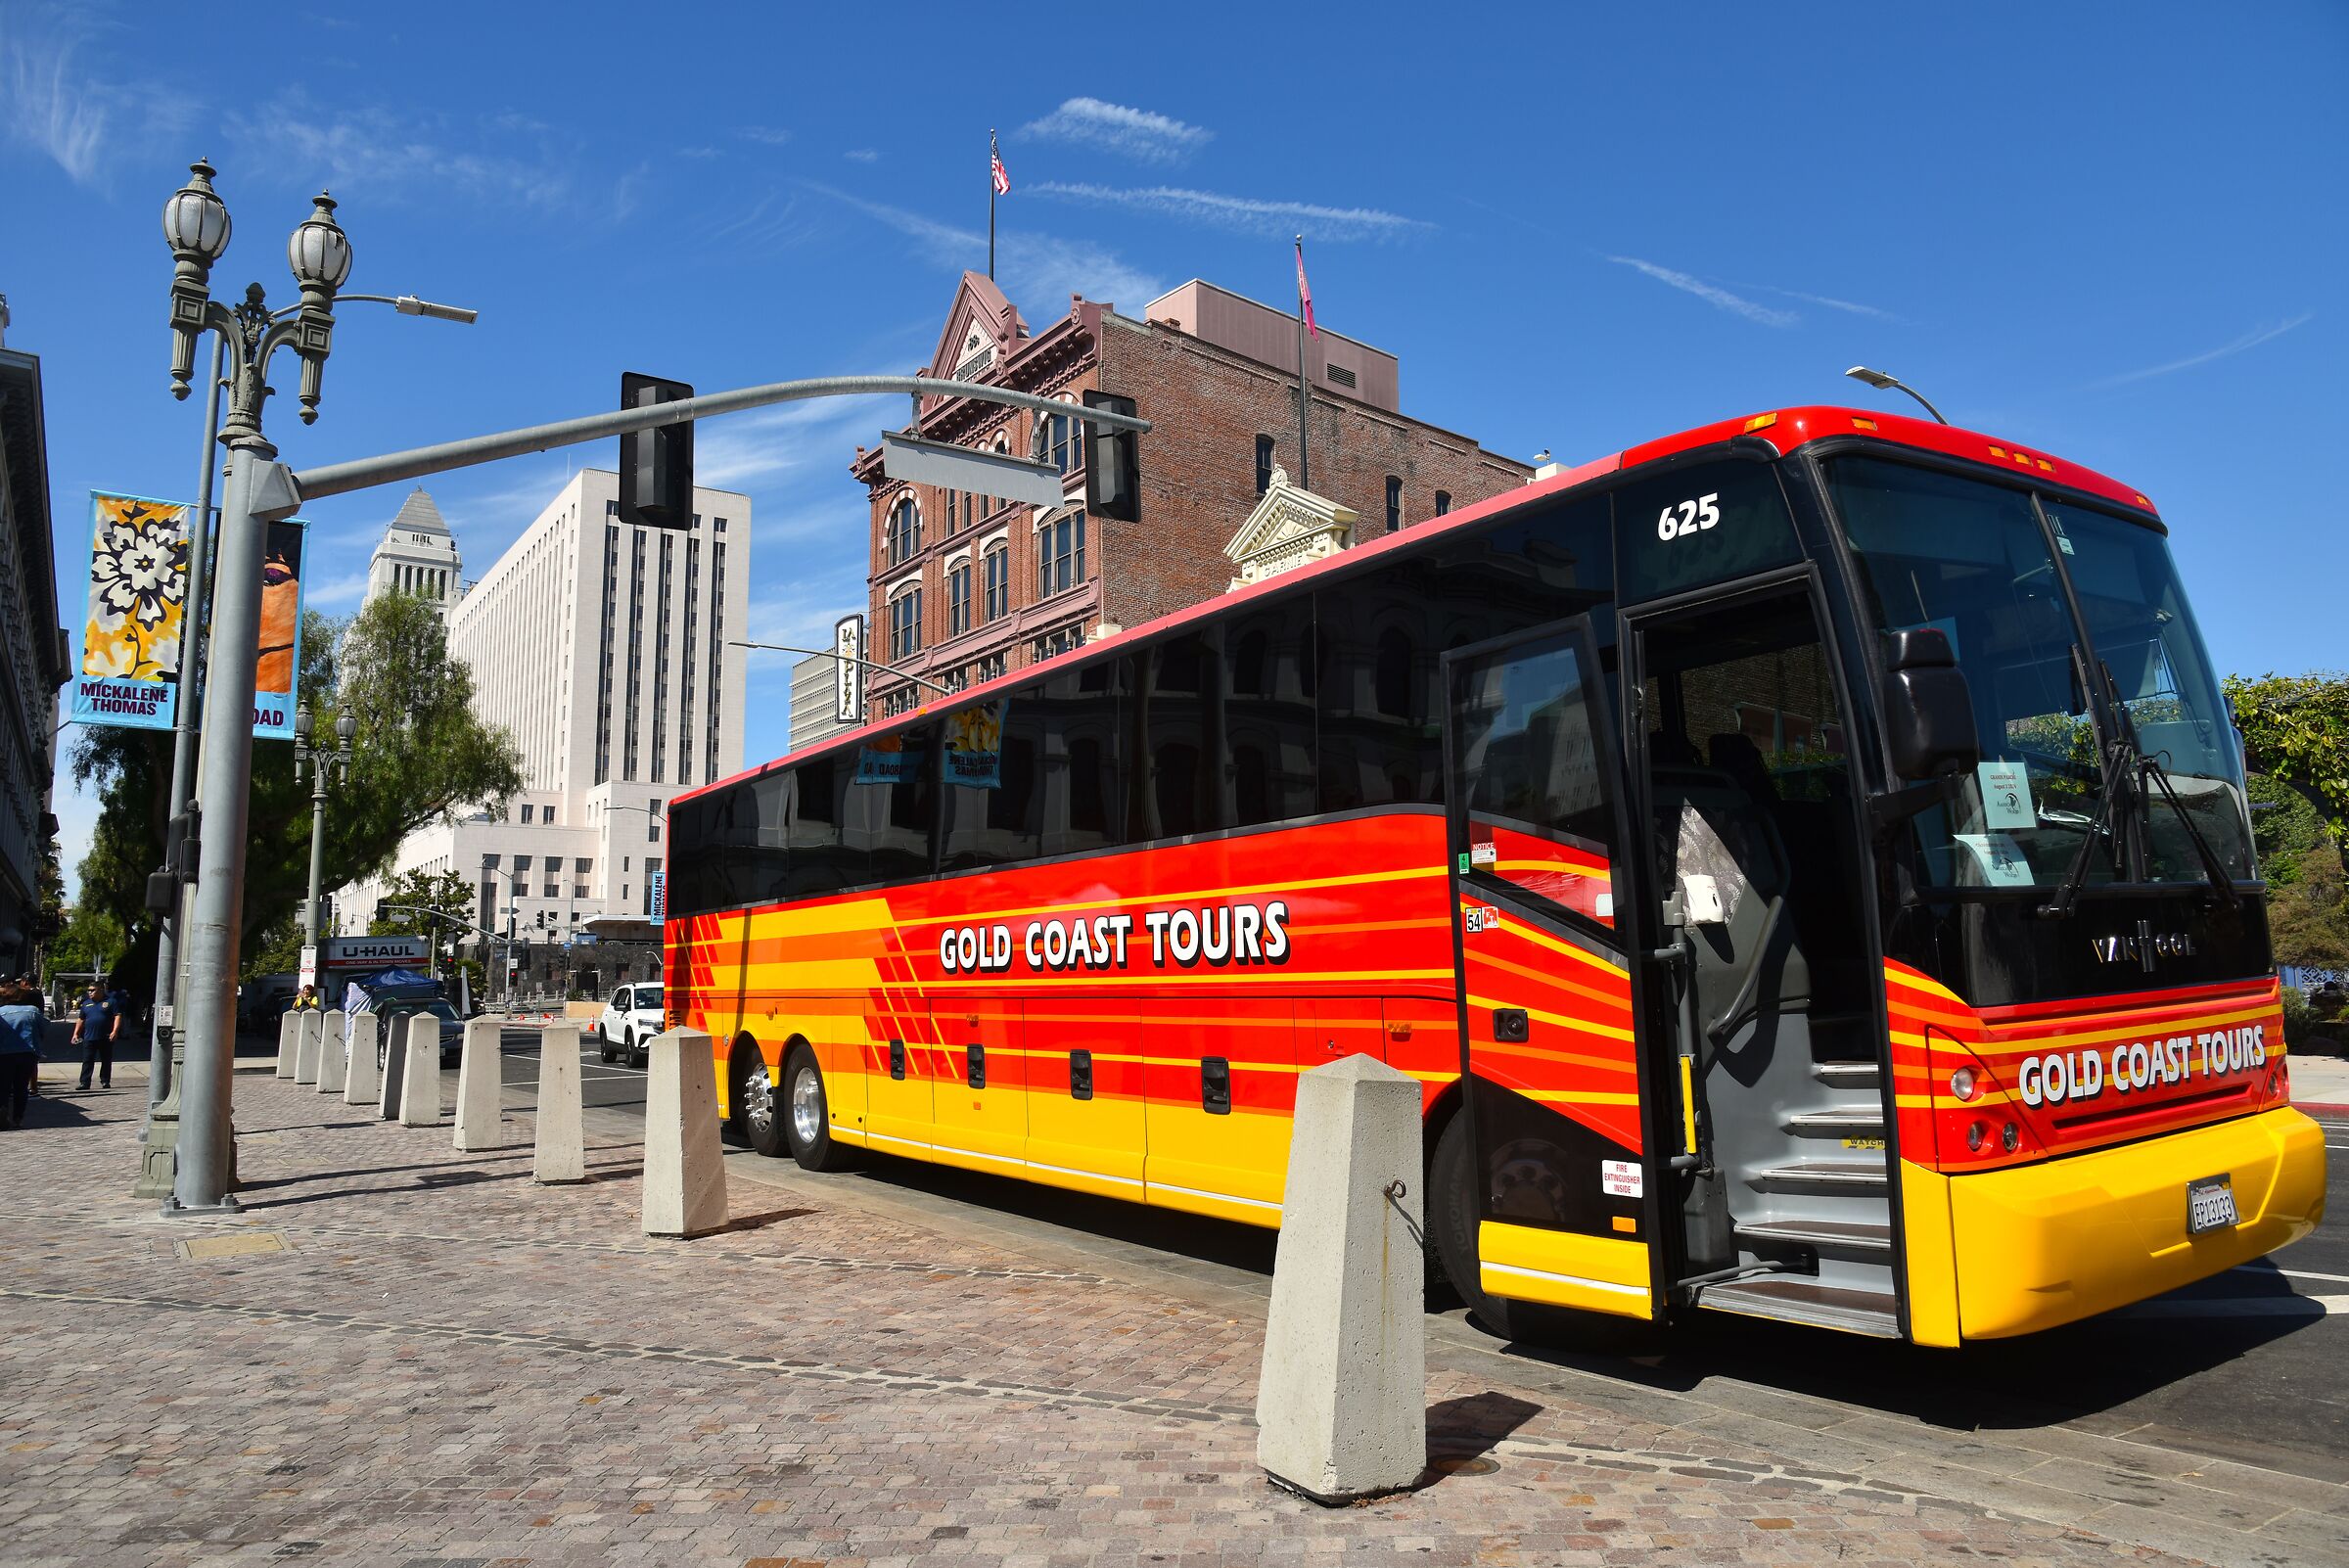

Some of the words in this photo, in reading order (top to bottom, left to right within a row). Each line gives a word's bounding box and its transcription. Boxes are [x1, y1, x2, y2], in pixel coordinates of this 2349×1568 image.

[1658, 492, 1720, 541] 625
[842, 627, 856, 642] LA
[80, 682, 168, 703] MICKALENE
[91, 698, 157, 715] THOMAS
[1473, 842, 1495, 851] NOTICE
[654, 875, 663, 916] MICKALENE
[1467, 913, 1481, 931] 54
[940, 924, 1012, 973] GOLD
[1025, 914, 1132, 971] COAST
[1145, 900, 1290, 968] TOURS
[343, 945, 415, 957] U-HAUL
[2019, 1049, 2103, 1106] GOLD
[2111, 1036, 2192, 1092] COAST
[2196, 1025, 2268, 1076] TOURS
[1616, 1164, 1628, 1173] FIRE
[1604, 1173, 1640, 1184] EXTINGUISHER
[1614, 1184, 1631, 1193] INSIDE
[2194, 1196, 2233, 1224] EP13133
